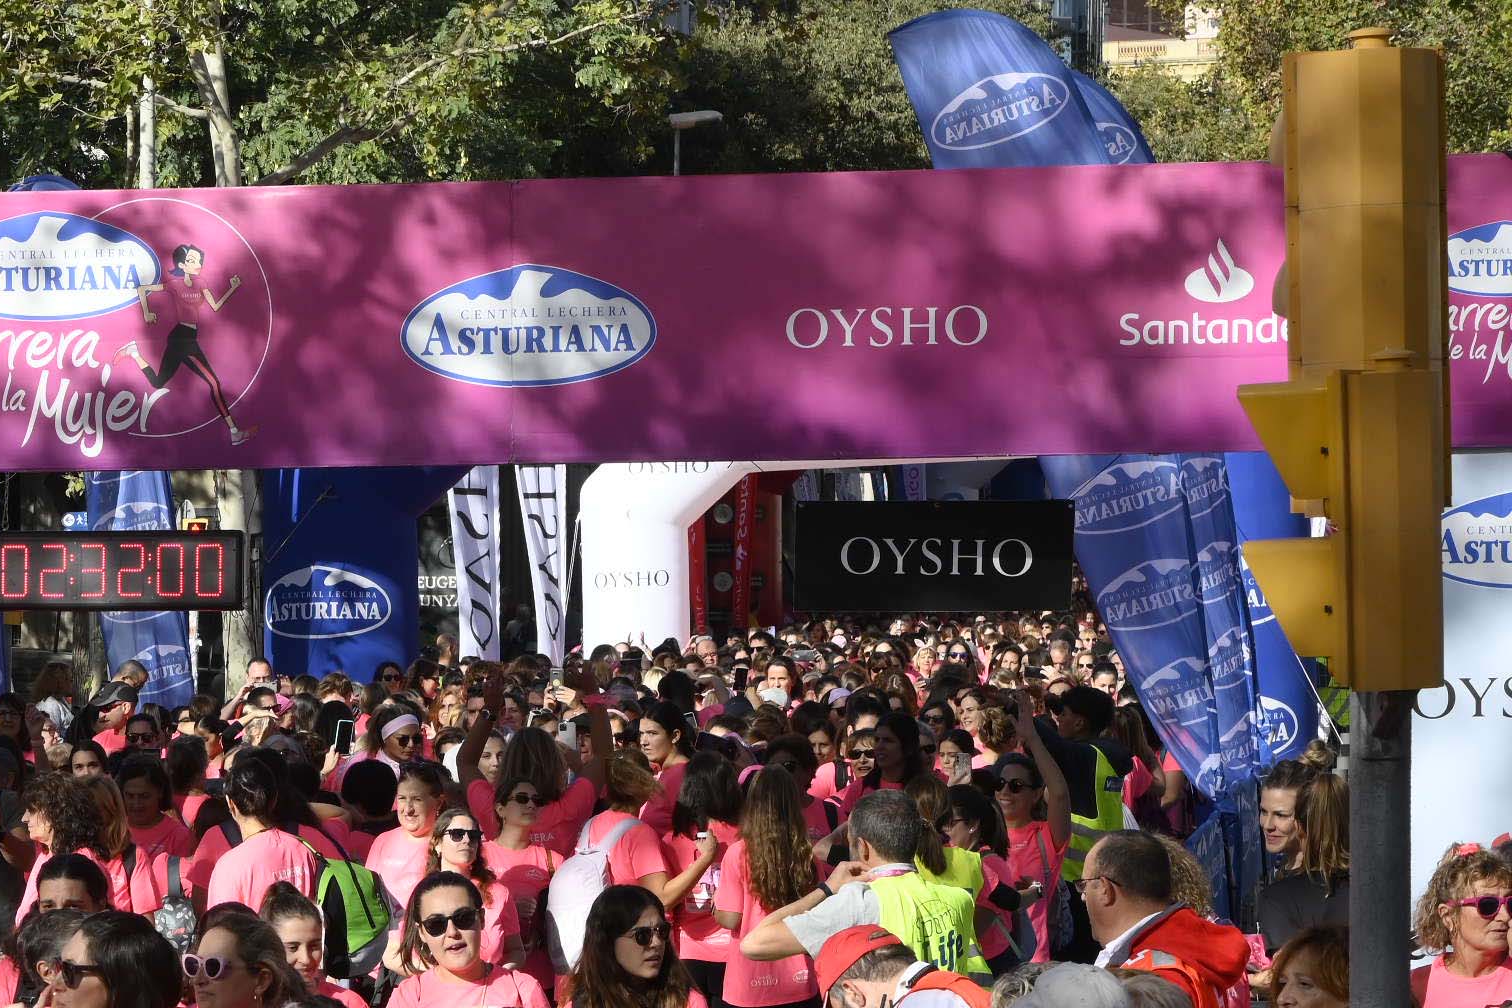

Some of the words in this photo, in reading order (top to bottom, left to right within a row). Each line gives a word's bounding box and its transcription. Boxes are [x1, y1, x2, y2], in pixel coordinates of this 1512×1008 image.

[460, 307, 538, 320] CENTRAL
[547, 306, 628, 318] LECHERA
[786, 304, 988, 349] OYSHO
[1448, 303, 1512, 331] arre
[421, 312, 636, 356] ASTURIANA
[1469, 334, 1486, 360] la
[1, 373, 26, 411] la
[21, 364, 170, 457] Mujer
[1, 544, 223, 598] 02:32:00
[841, 537, 1033, 577] OYSHO
[593, 570, 670, 591] OYSHO
[270, 595, 382, 623] ASTURIANA
